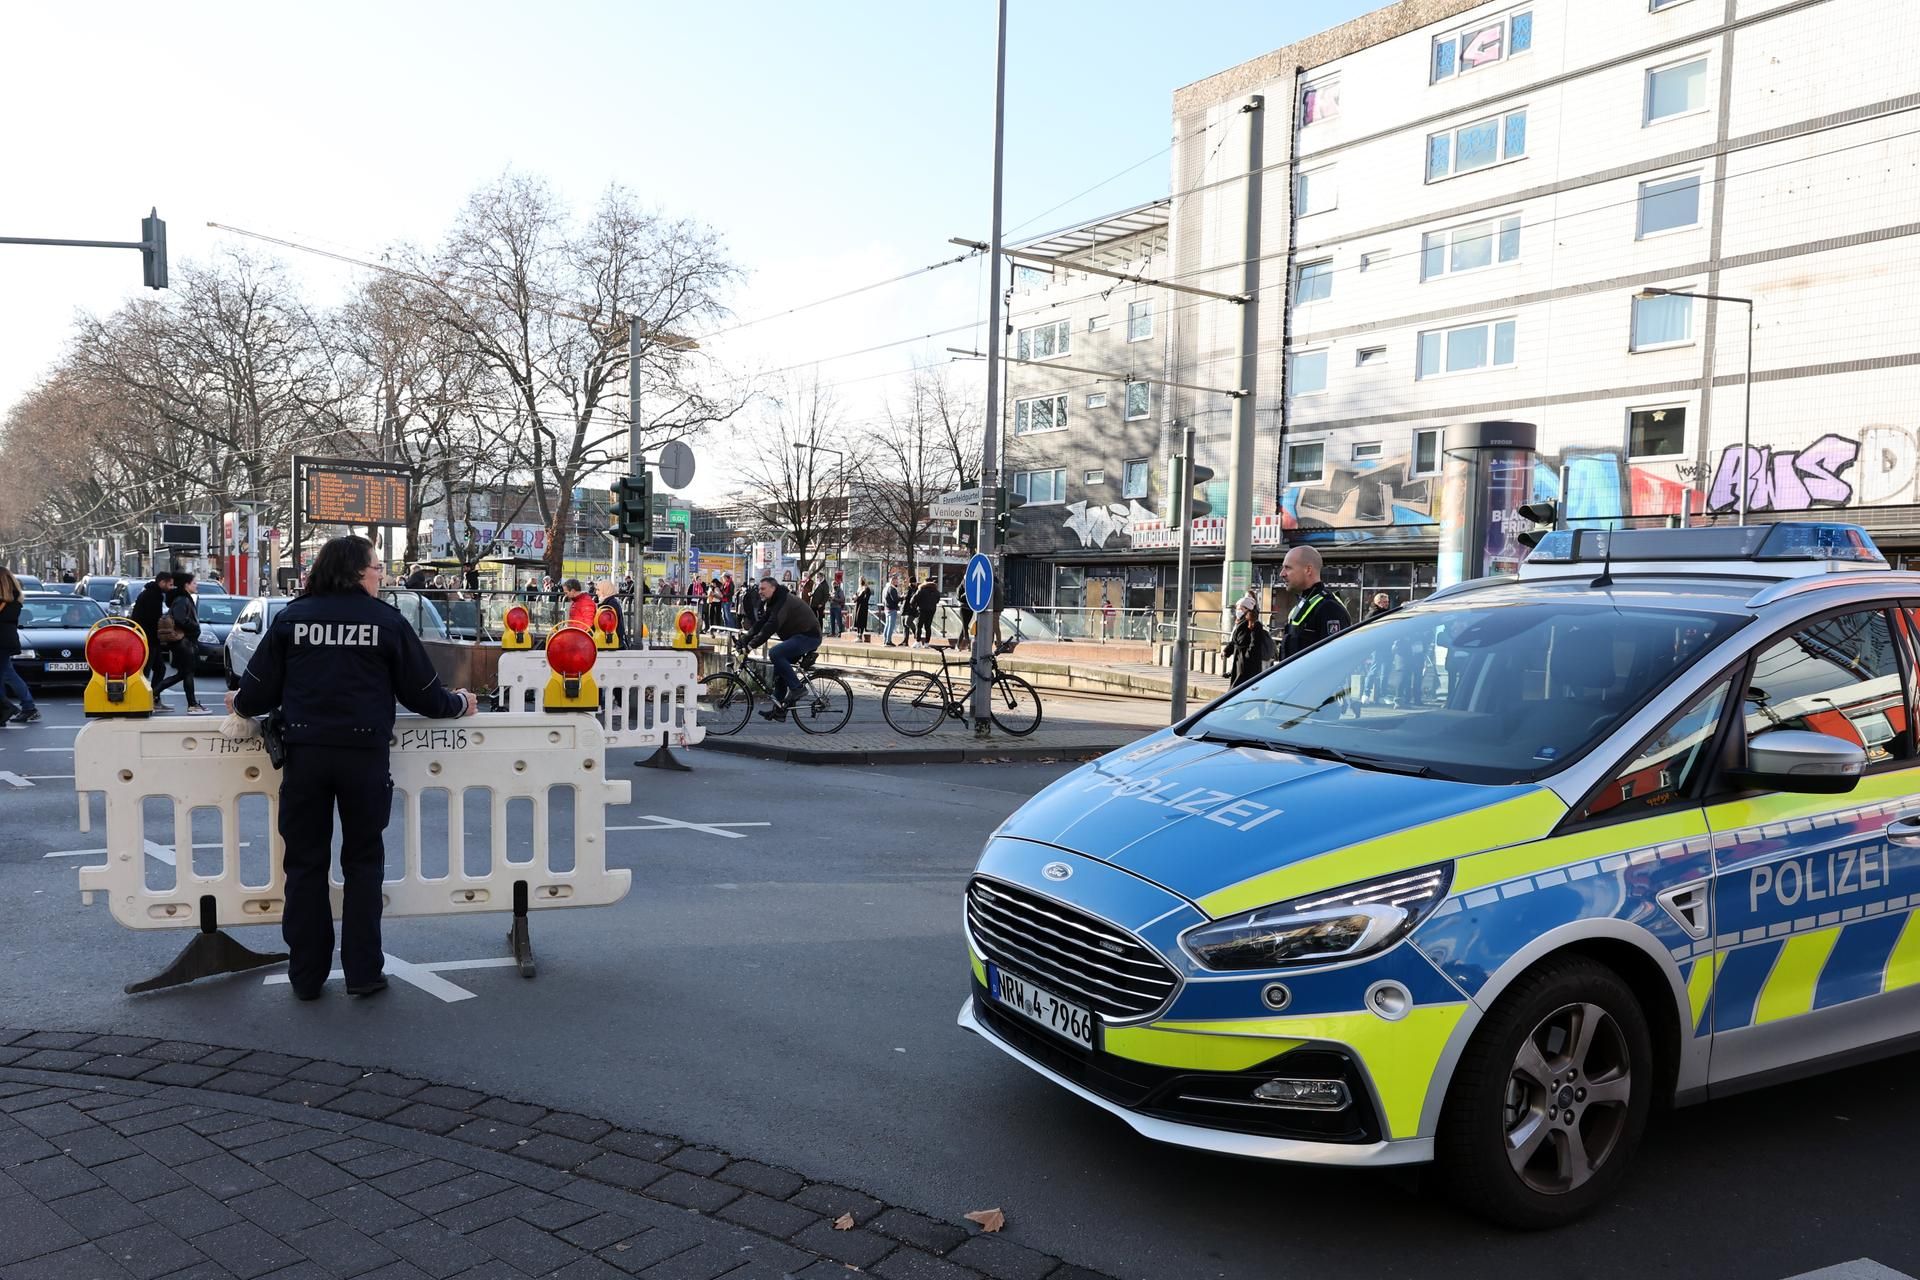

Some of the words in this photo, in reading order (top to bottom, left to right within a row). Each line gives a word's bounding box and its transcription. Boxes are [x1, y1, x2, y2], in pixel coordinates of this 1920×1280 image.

[934, 506, 962, 517] Venloer
[964, 508, 978, 517] Str.
[294, 623, 379, 646] POLIZEI
[1083, 777, 1285, 832] POLIZEI
[1749, 843, 1890, 913] POLIZEI
[998, 970, 1025, 1010] NRW
[1034, 990, 1092, 1044] 4-7966
